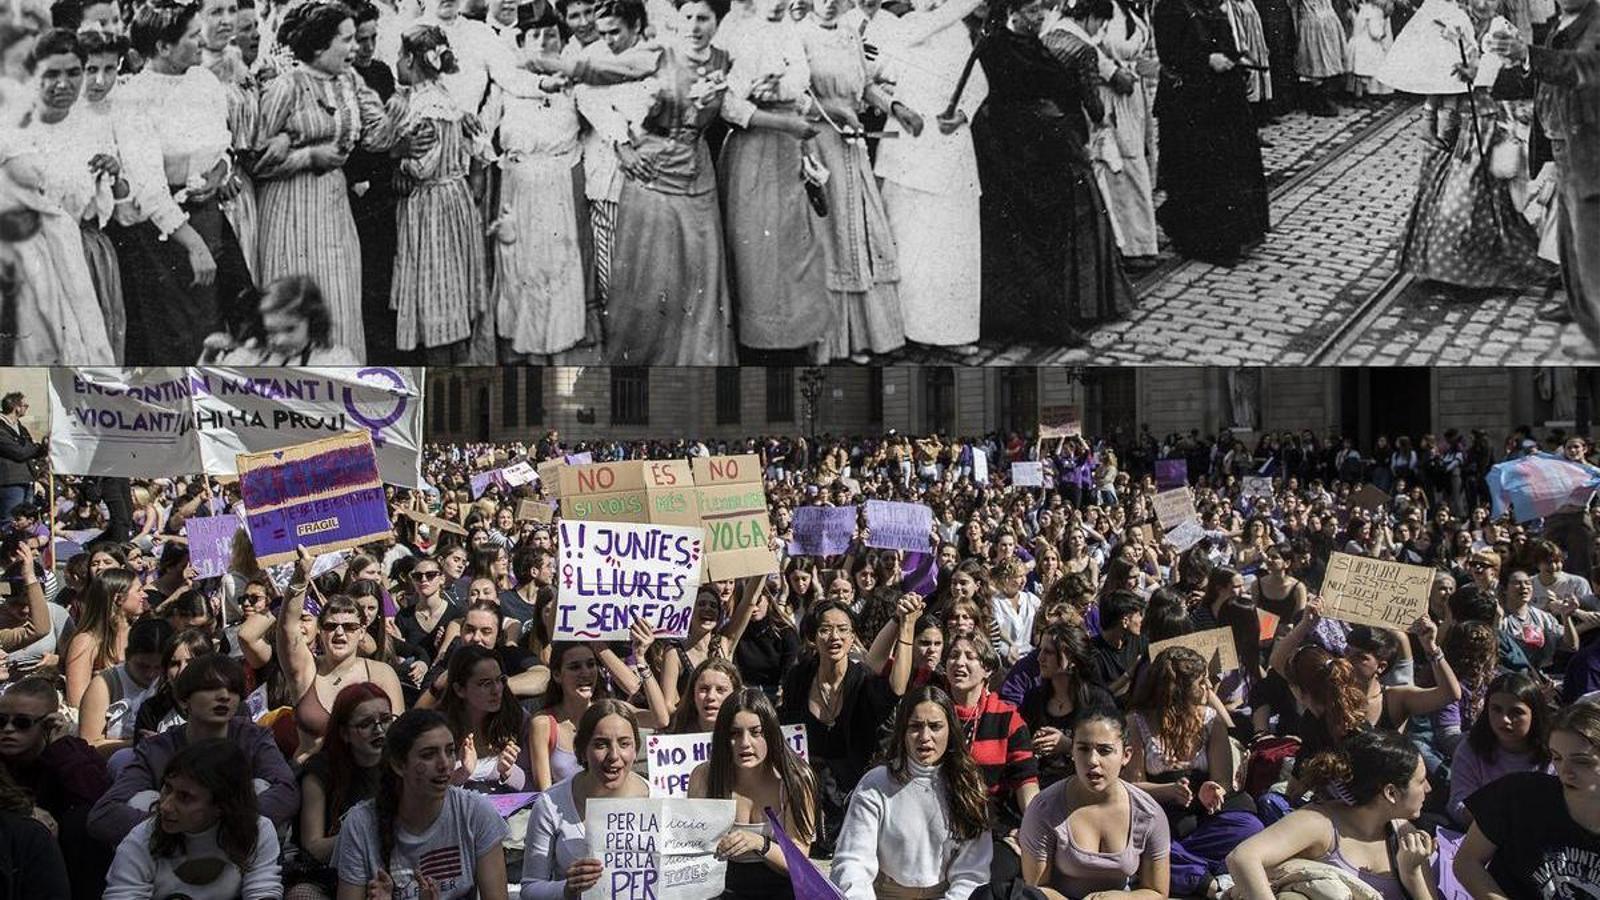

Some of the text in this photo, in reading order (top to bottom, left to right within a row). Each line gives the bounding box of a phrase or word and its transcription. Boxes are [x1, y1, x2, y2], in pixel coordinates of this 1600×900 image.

[221, 377, 319, 401] MATANT
[227, 410, 267, 430] HA
[578, 466, 615, 493] NO
[651, 460, 676, 486] ÉS
[708, 458, 739, 481] NO
[708, 518, 768, 551] YOGA
[593, 528, 691, 567] JUNTES
[1333, 557, 1400, 581] SUPPORT
[576, 566, 687, 602] LLIURES
[1350, 574, 1409, 596] SISTERS
[1389, 594, 1418, 608] YOUR
[557, 603, 693, 633] I SENSE POR
[656, 747, 686, 767] NO
[607, 812, 636, 831] PER
[639, 813, 660, 833] LA
[605, 832, 634, 850] PER
[637, 834, 656, 852] LA
[604, 851, 633, 869] PER
[636, 852, 655, 869] LA
[611, 869, 659, 900] PER
